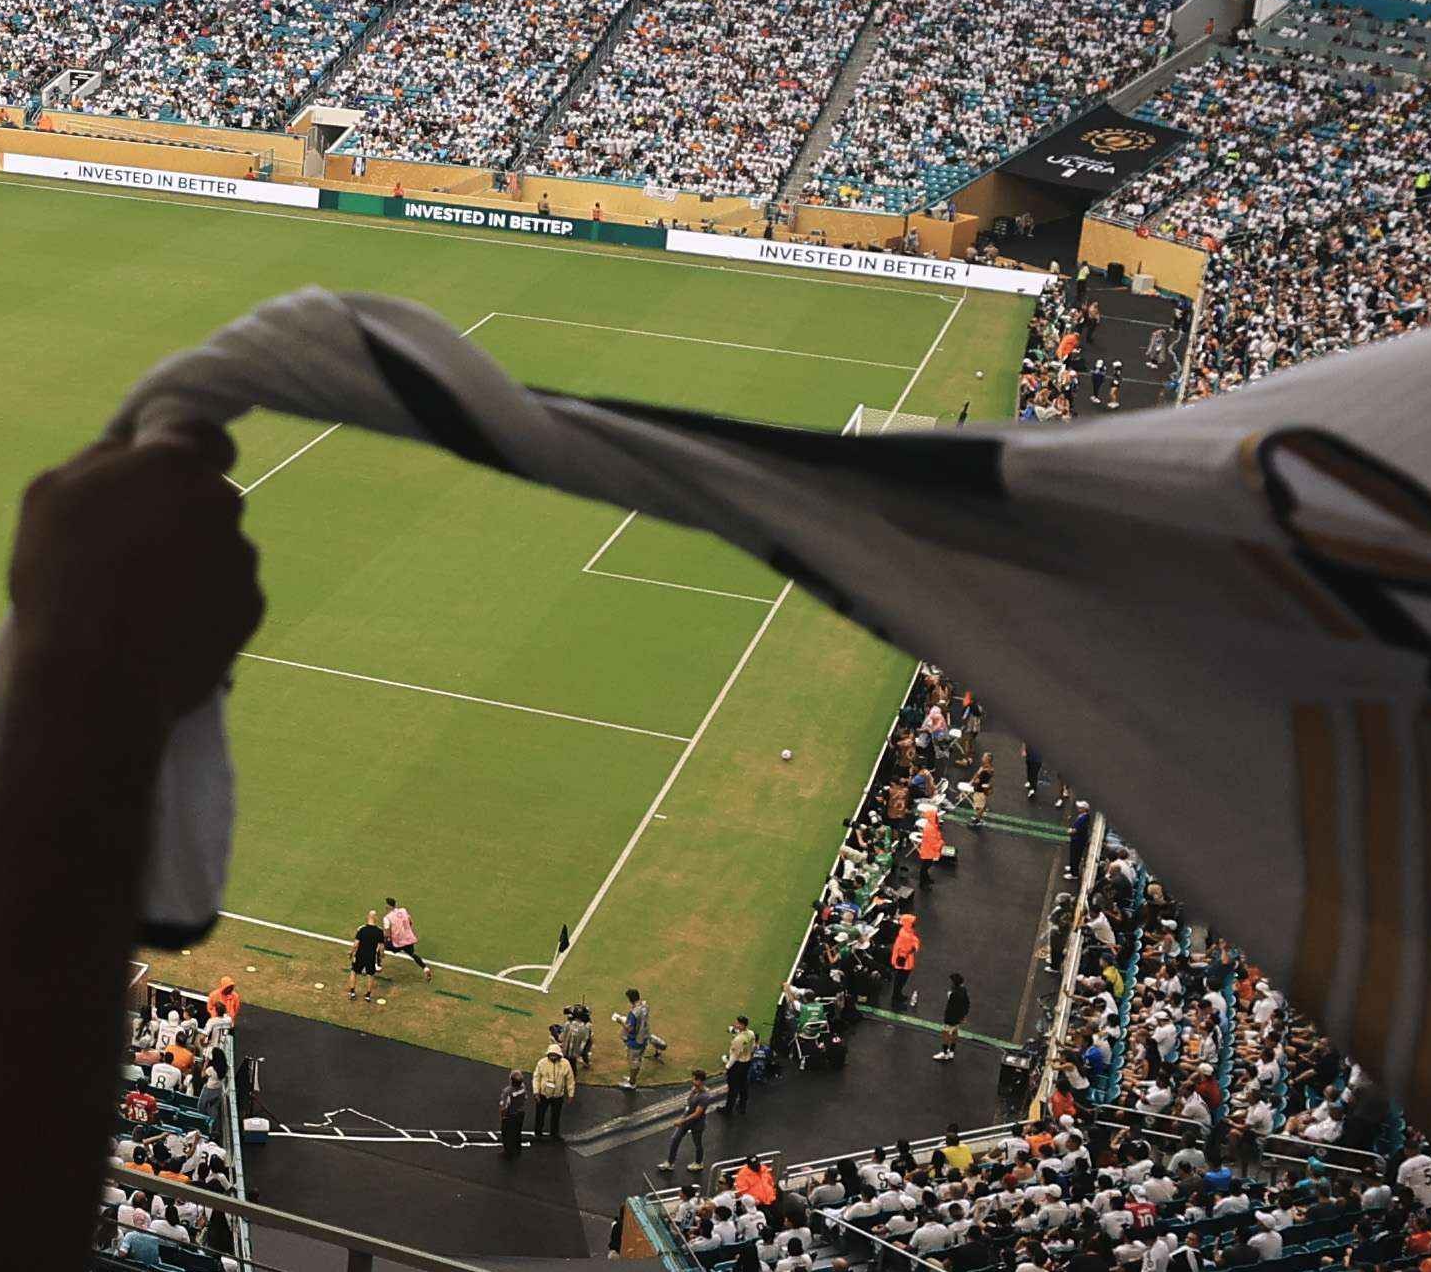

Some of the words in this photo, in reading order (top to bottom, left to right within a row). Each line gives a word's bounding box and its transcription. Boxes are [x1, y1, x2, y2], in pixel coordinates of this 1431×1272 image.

[77, 165, 154, 186] INVESTED
[158, 174, 173, 188] IN
[176, 175, 237, 195] BETTER
[1046, 155, 1116, 174] ULTRA
[405, 202, 485, 225] INVESTED
[488, 211, 505, 227] IN
[510, 214, 573, 235] BETTER
[759, 244, 854, 270] INVESTED
[858, 251, 876, 269] IN
[881, 255, 957, 280] BETTER
